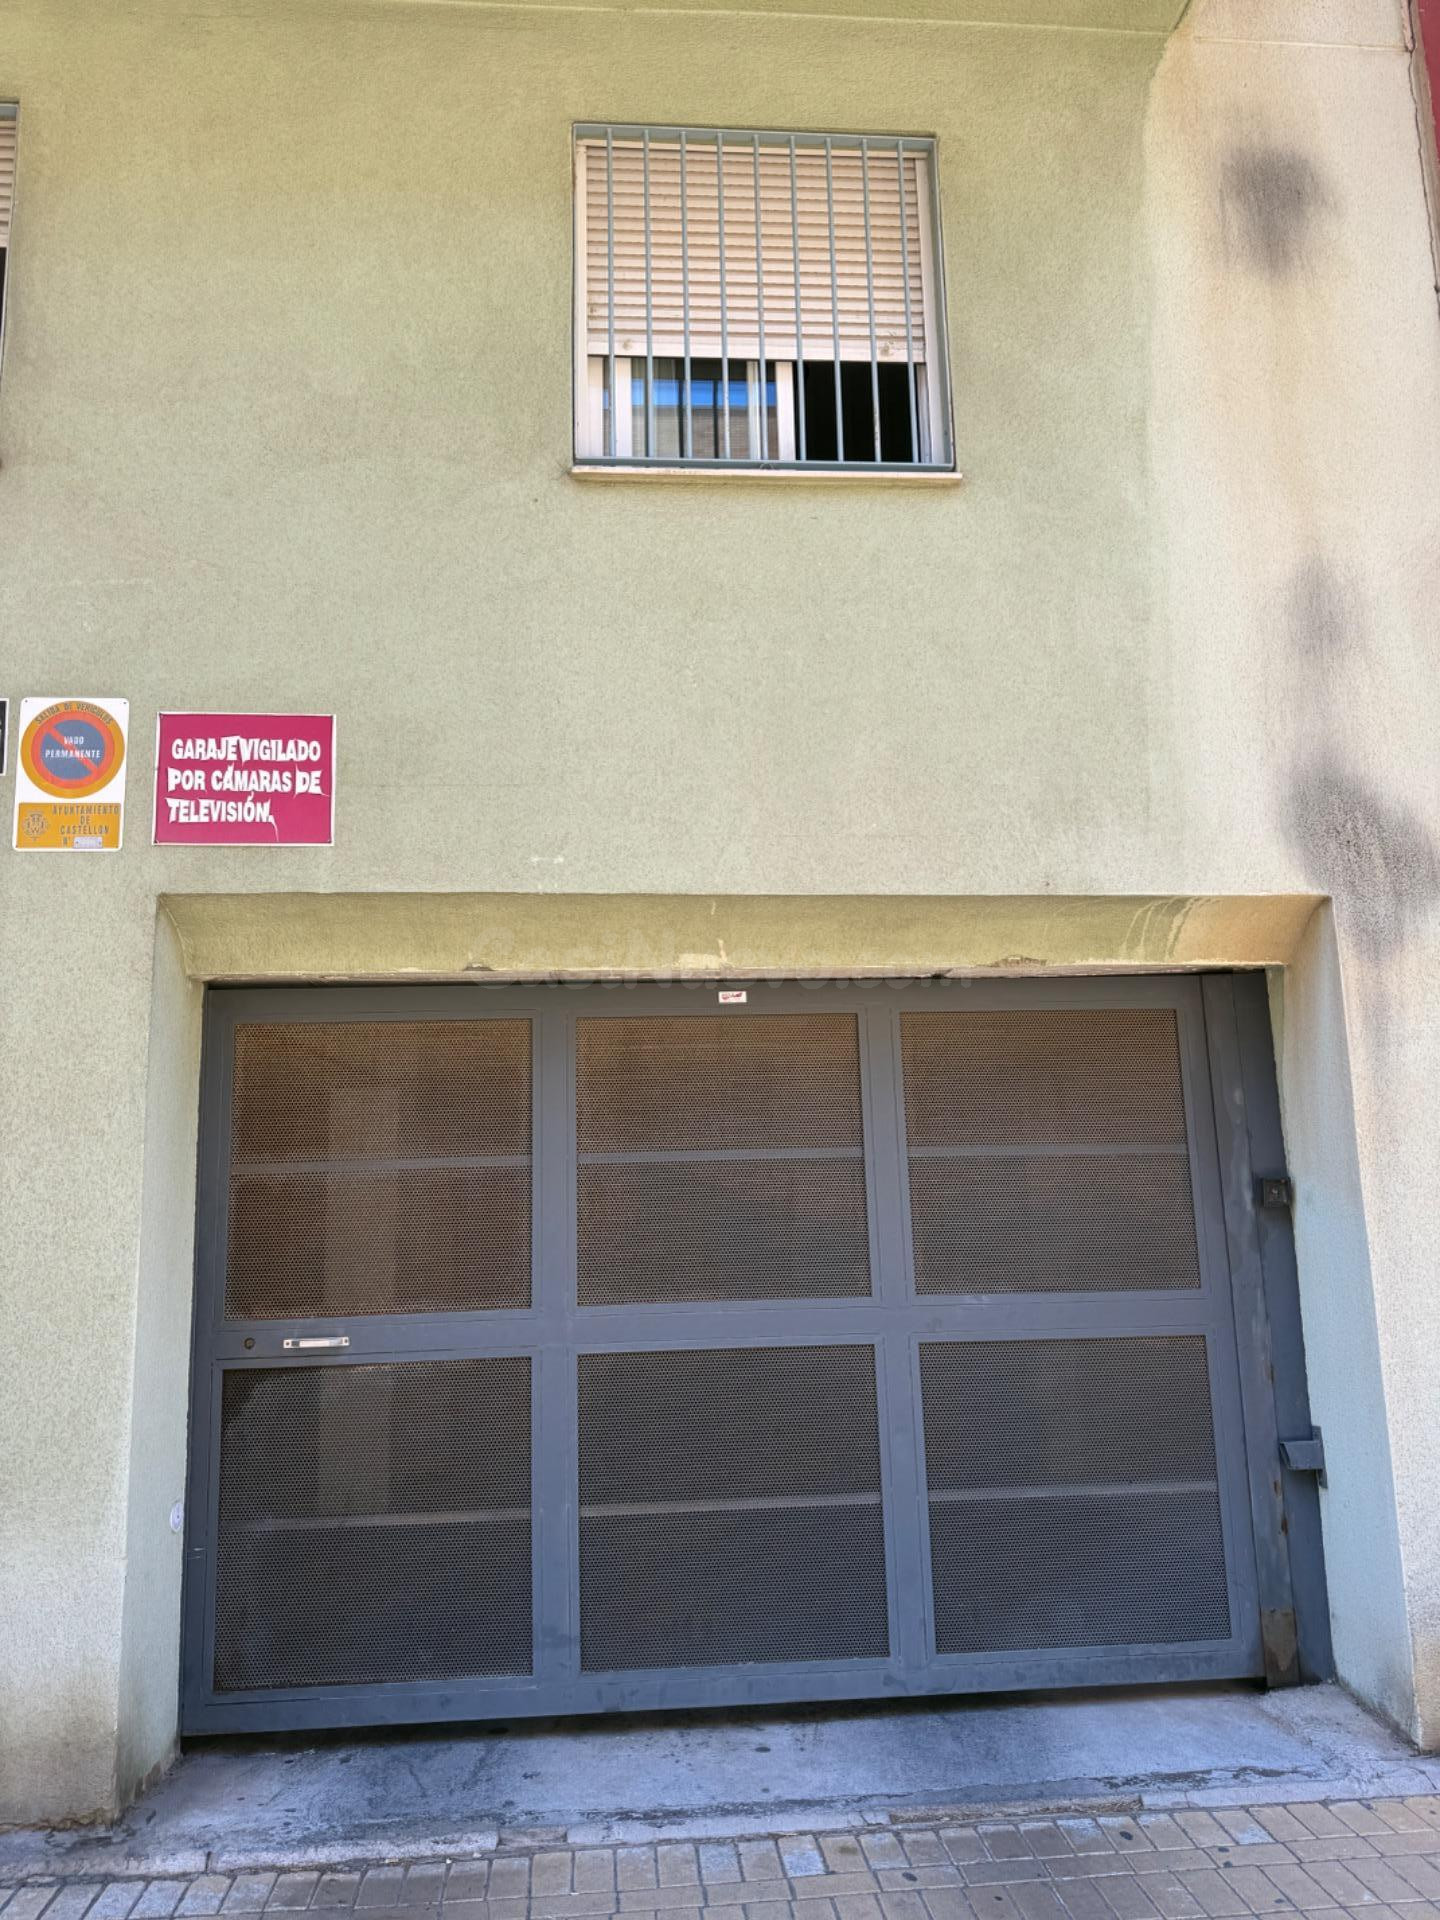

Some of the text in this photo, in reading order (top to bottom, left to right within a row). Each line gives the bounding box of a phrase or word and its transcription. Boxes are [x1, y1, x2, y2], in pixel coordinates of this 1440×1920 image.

[64, 736, 84, 745] VADO
[45, 748, 101, 758] PERMANENTE
[171, 736, 321, 764] GARAJE VIGILADO
[167, 764, 323, 796] POR CÁMARAS DE
[52, 805, 119, 815] AYUNTAMIENTO
[80, 815, 91, 825] DE
